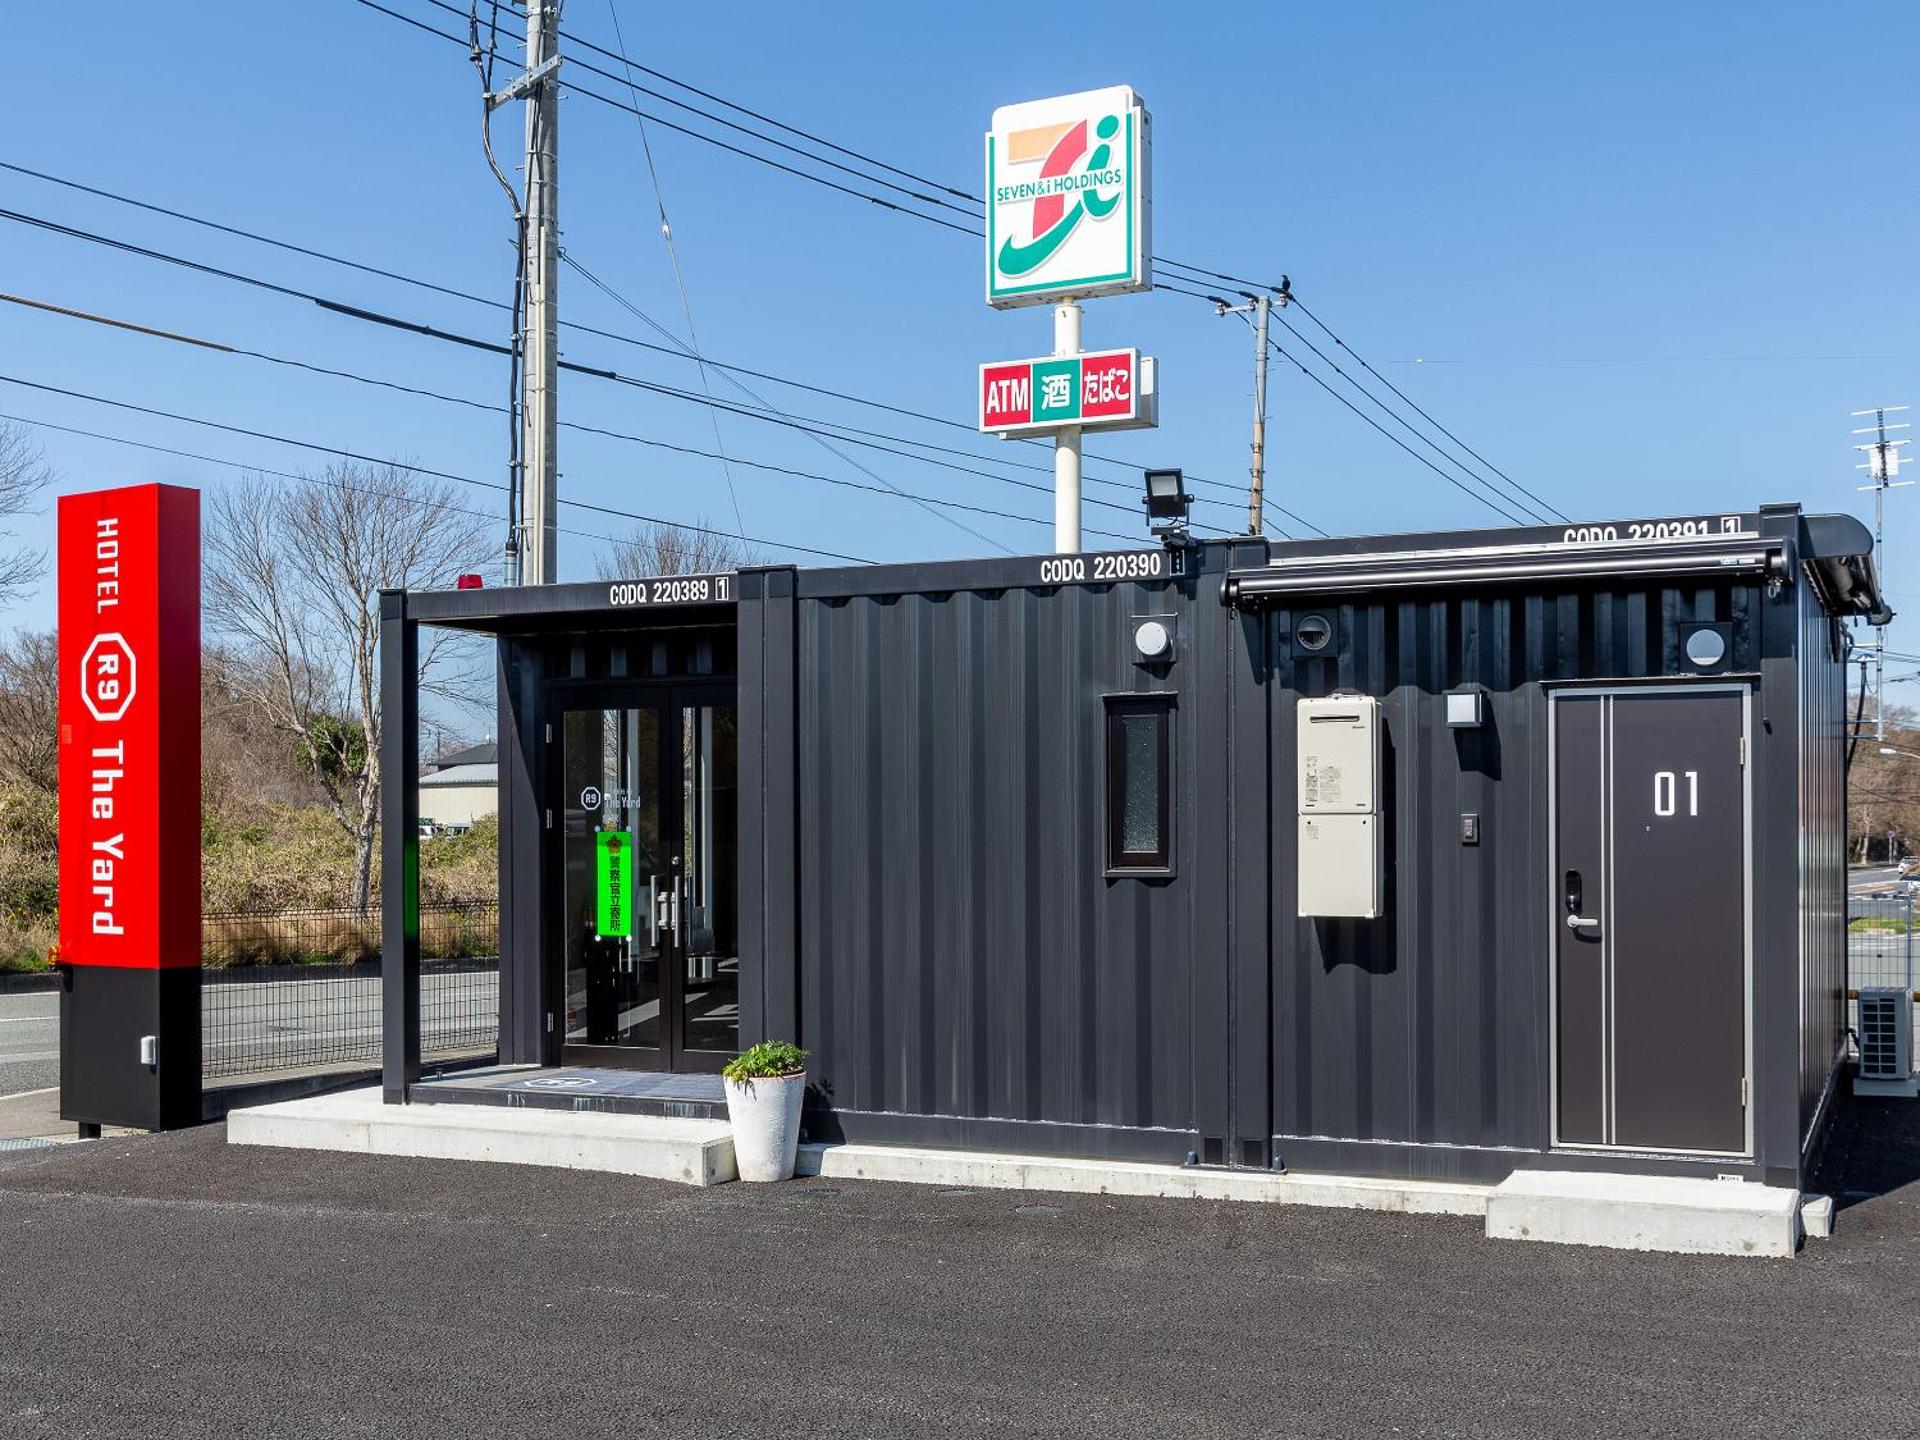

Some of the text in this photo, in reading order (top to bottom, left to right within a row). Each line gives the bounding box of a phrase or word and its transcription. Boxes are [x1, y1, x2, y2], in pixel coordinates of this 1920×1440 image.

[1054, 169, 1122, 191] HOLDINGS
[986, 377, 1029, 414] ATM
[1041, 373, 1071, 410] 酒
[1084, 366, 1130, 405] たばこ
[96, 517, 119, 614] HOTEL
[1041, 558, 1085, 582] CODQ
[1094, 552, 1161, 579] 220390
[610, 583, 647, 605] CODQ
[653, 579, 708, 603] 220389
[97, 654, 119, 700] R9
[1654, 771, 1698, 816] 01
[92, 739, 124, 935] The Yard
